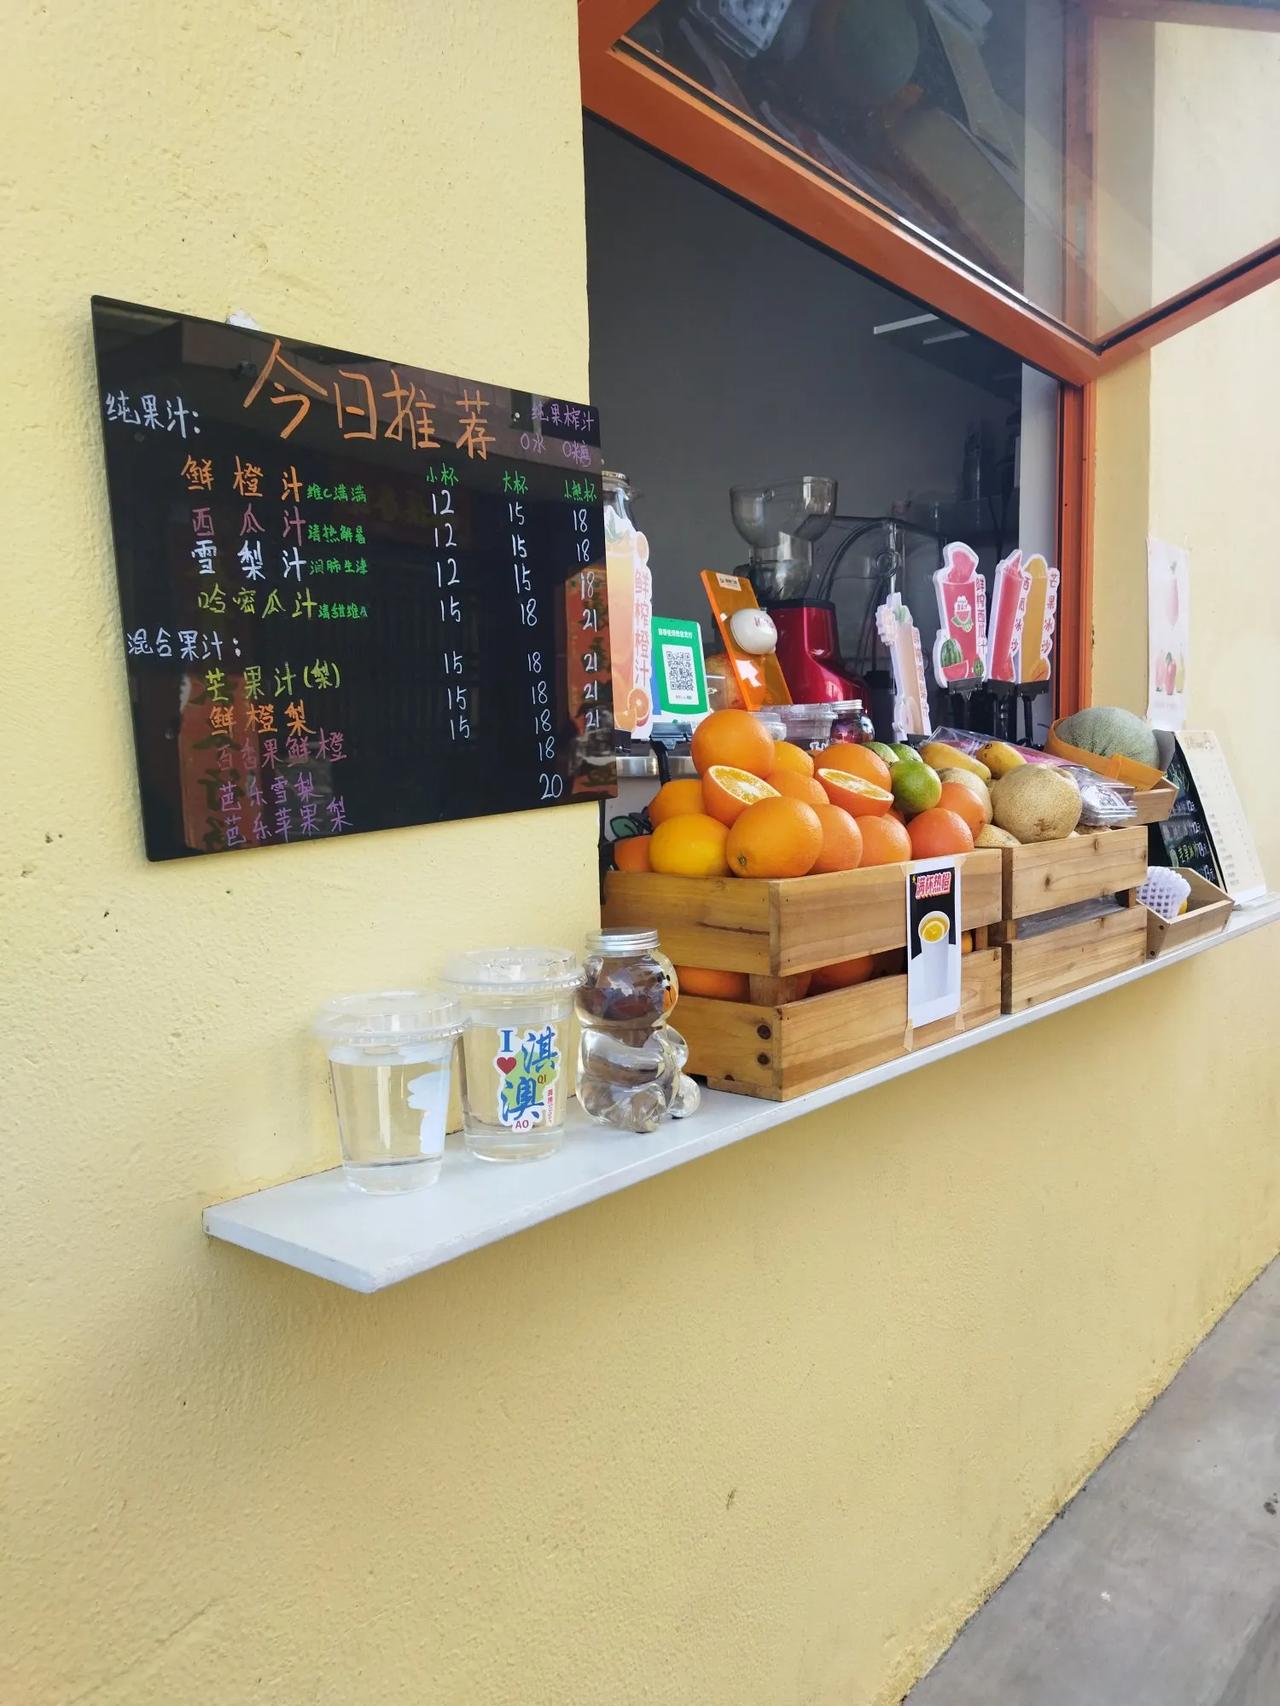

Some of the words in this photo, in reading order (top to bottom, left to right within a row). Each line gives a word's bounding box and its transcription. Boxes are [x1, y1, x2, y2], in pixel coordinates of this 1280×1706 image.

[242, 337, 496, 461] 今日推荐
[180, 454, 303, 503] 鲜橙汁
[431, 489, 454, 515] 12
[508, 501, 525, 525] 15
[572, 508, 588, 533] 18
[426, 463, 459, 486] 小杯
[502, 470, 528, 494] 大杯
[564, 479, 597, 502] 小熊杯
[192, 502, 307, 546] 西瓜汁
[434, 522, 457, 548] 12
[511, 533, 528, 558] 15
[576, 538, 590, 562] 18
[191, 540, 307, 582] 雪梨汁
[436, 557, 460, 588] 12
[513, 563, 531, 594] 15
[580, 571, 595, 599] 18
[198, 583, 318, 620] 哈密瓜汁
[440, 595, 461, 623] 15
[520, 598, 538, 627] 18
[582, 608, 597, 632] 21
[634, 568, 649, 689] 鲜榨橙汁
[1041, 572, 1059, 654] 芒果冰沙
[444, 650, 463, 675] 15
[527, 651, 542, 674] 18
[583, 653, 598, 672] 21
[208, 699, 317, 737] 鲜橙梨
[447, 685, 467, 710] 15
[531, 680, 548, 705] 18
[583, 679, 598, 701] 21
[217, 727, 348, 771] 百香果鲜橙
[450, 715, 470, 741] 15
[535, 708, 552, 735] 18
[585, 709, 600, 729] 21
[219, 771, 325, 812] 芭乐雪梨
[538, 735, 555, 761] 18
[224, 796, 353, 847] 芭乐苹果梨
[538, 773, 563, 800] 20
[501, 1030, 514, 1053] I
[521, 1026, 559, 1073] 淇
[500, 1076, 545, 1122] 澳
[537, 1074, 547, 1085] QI
[515, 1119, 529, 1129] AO
